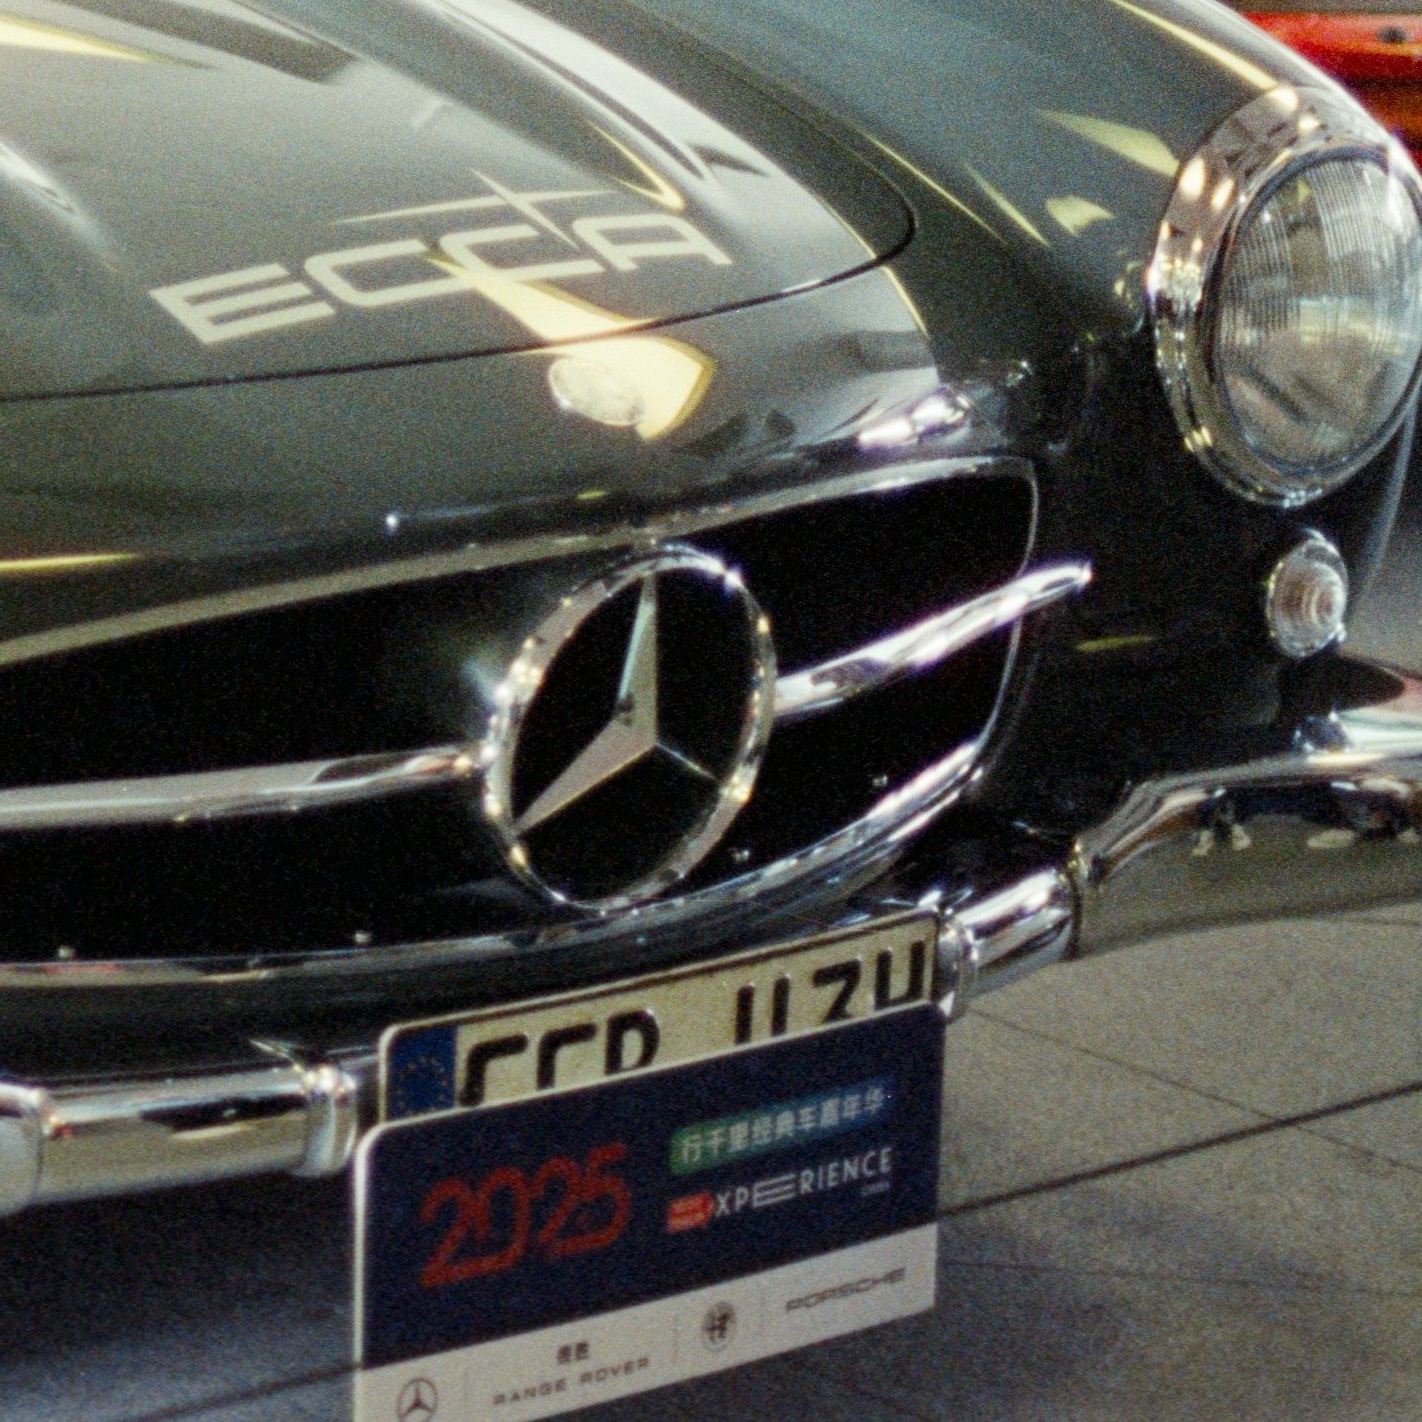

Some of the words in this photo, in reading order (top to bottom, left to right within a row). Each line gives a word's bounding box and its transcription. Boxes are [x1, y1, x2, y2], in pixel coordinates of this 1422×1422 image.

[148, 211, 734, 346] ECCA
[419, 1141, 632, 1288] 2025
[785, 1266, 907, 1313] PORSCHE
[493, 1377, 567, 1406] RANGE
[579, 1356, 650, 1386] ROVER
